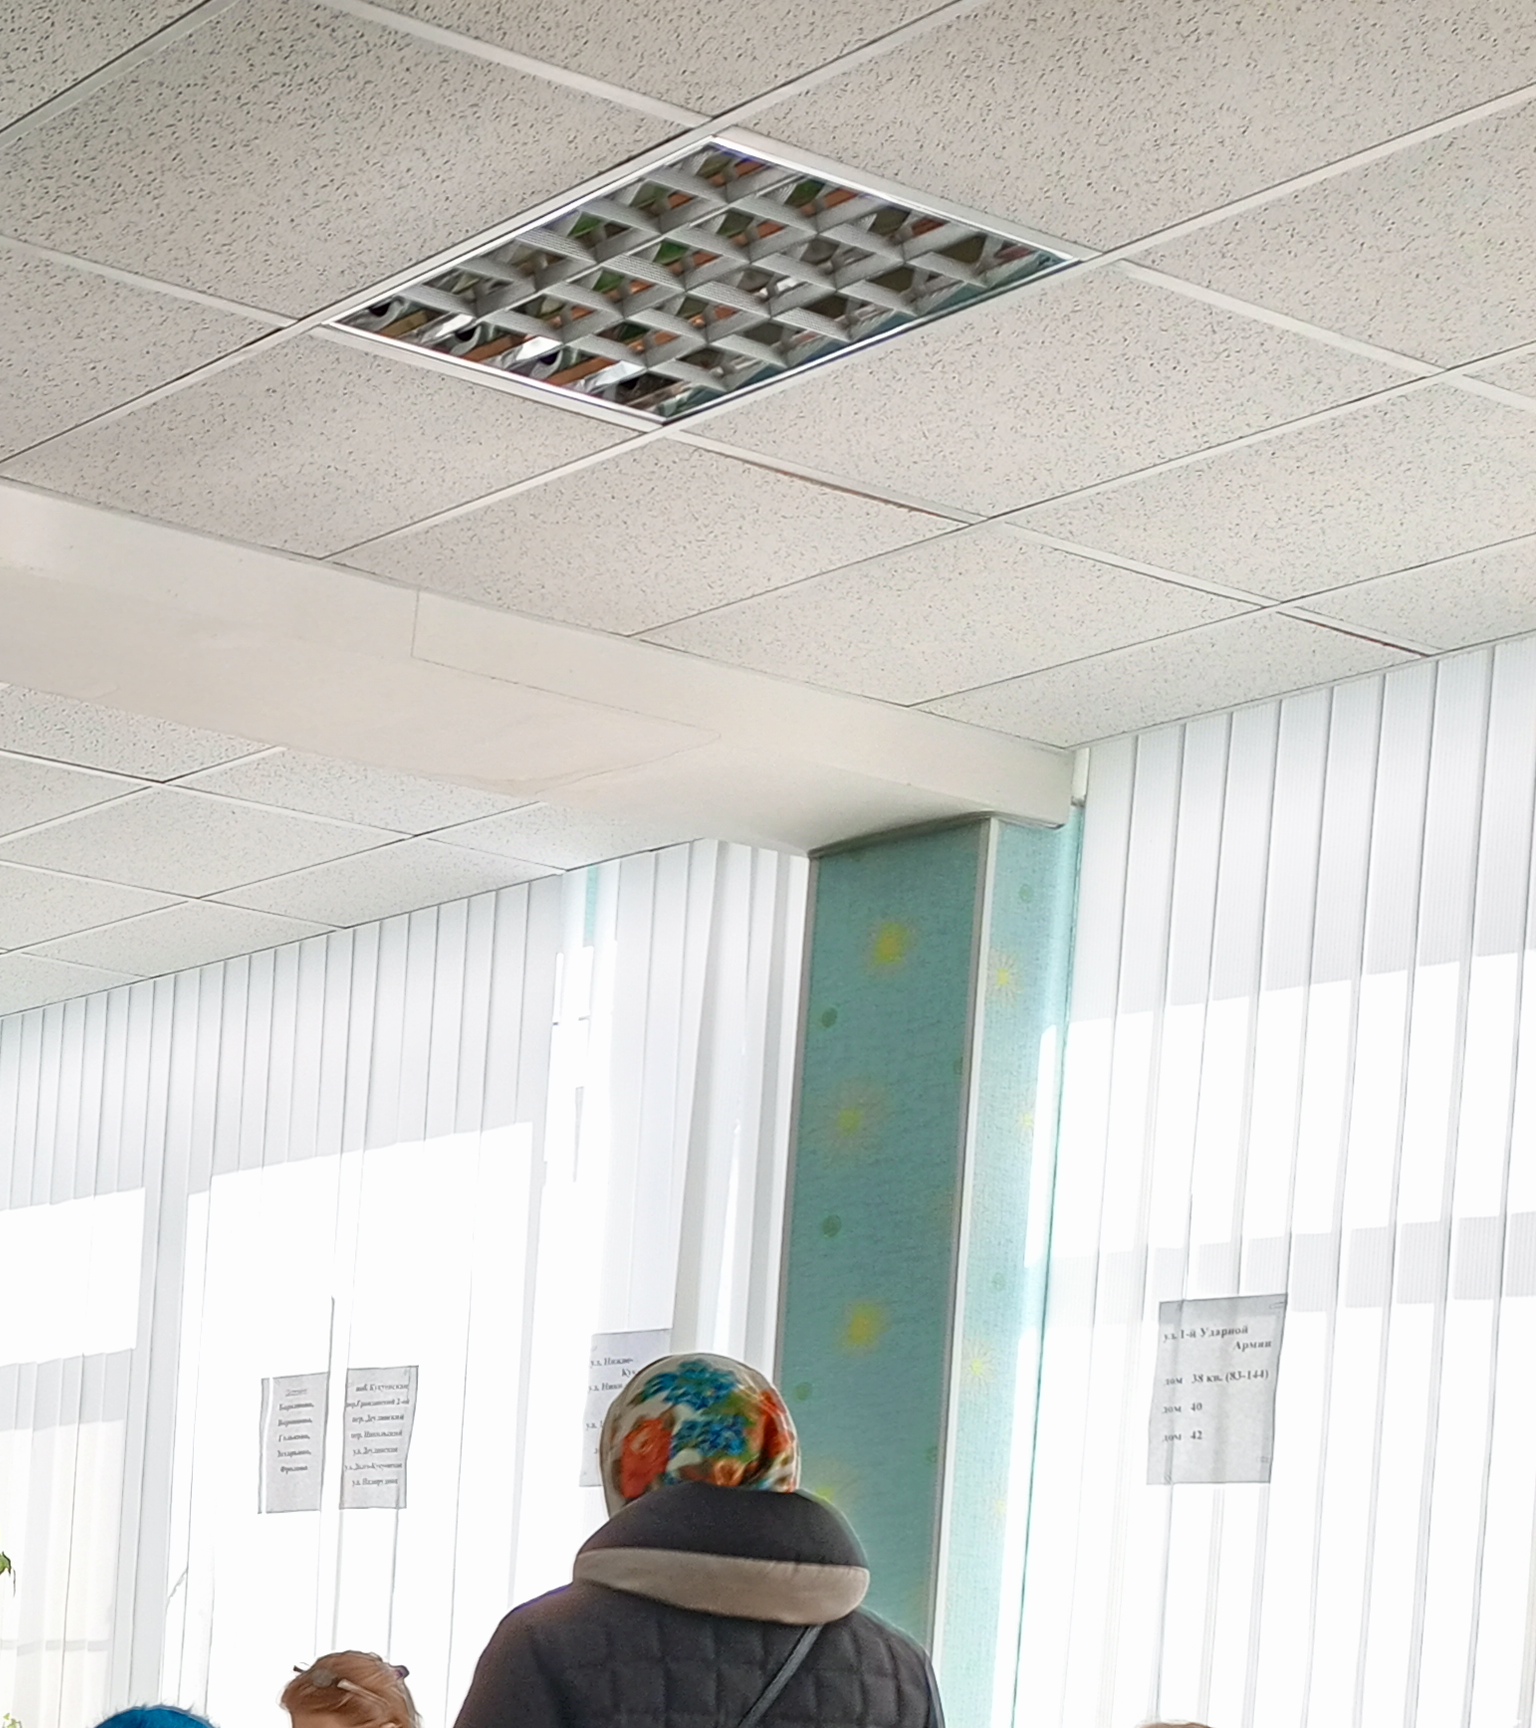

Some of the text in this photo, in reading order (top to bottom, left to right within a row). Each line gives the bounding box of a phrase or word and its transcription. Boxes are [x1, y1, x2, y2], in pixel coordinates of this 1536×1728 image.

[1200, 1324, 1249, 1339] Ударной
[1232, 1340, 1272, 1353] Армии
[1190, 1402, 1203, 1412] 40
[1190, 1430, 1203, 1440] 42
